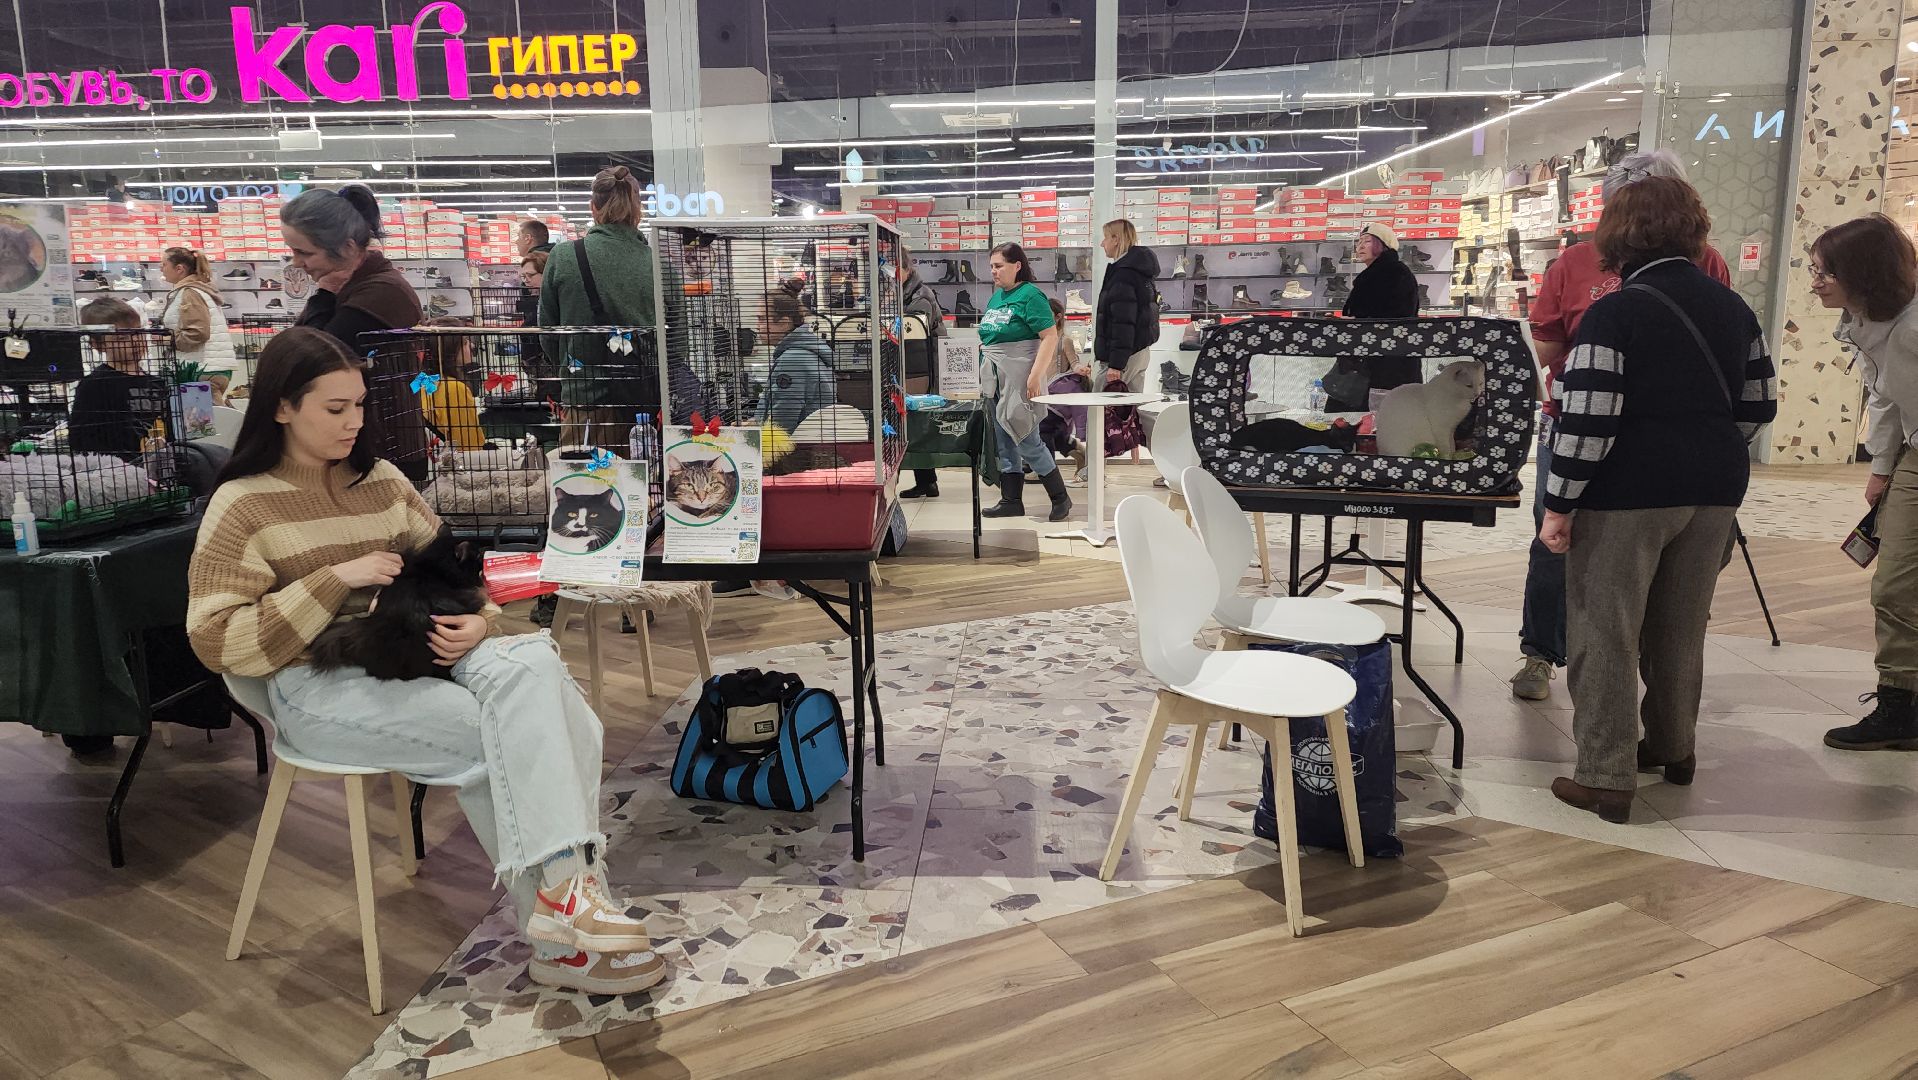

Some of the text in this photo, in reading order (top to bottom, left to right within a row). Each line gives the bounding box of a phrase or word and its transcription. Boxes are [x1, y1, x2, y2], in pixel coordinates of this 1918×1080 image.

[231, 1, 468, 103] kari
[488, 34, 638, 76] ГИПЕР
[152, 68, 216, 104] ТО
[1292, 757, 1358, 776] ЕГАПОС
